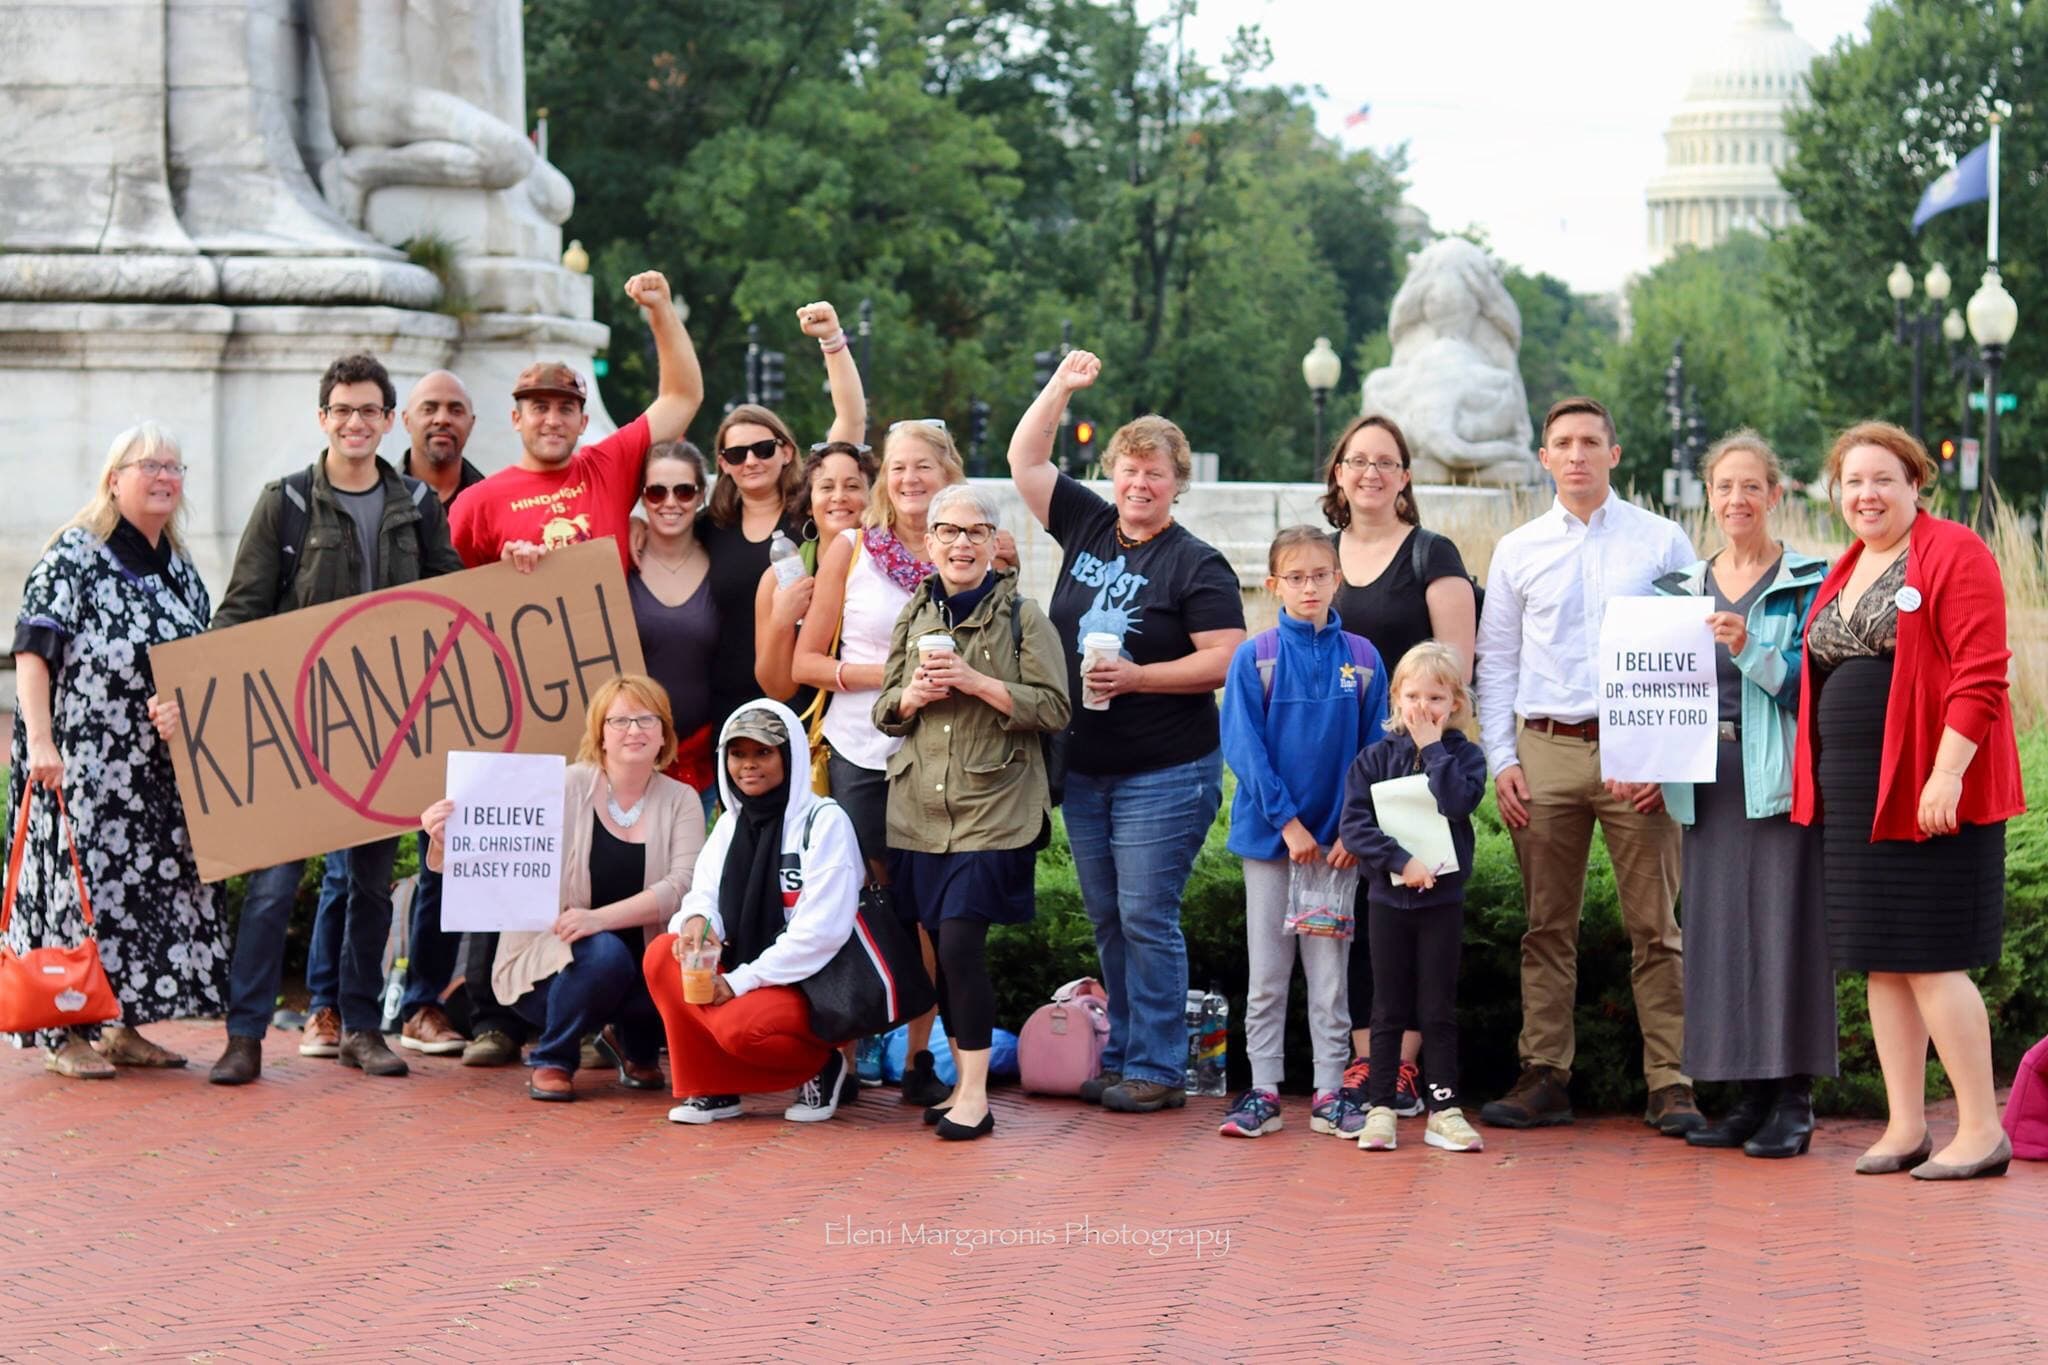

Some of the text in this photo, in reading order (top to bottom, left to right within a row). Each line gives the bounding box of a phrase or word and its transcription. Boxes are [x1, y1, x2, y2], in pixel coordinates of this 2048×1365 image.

[1616, 651, 1697, 672] I BELIEVE
[174, 583, 622, 815] KAVANAUGH
[1606, 682, 1710, 699] DR. CHRISTINE
[1609, 709, 1708, 726] BLASEY FORD
[464, 806, 545, 826] I BELIEVE
[452, 836, 555, 852] DR. CHRISTINE
[453, 862, 551, 878] BLASEY FORD
